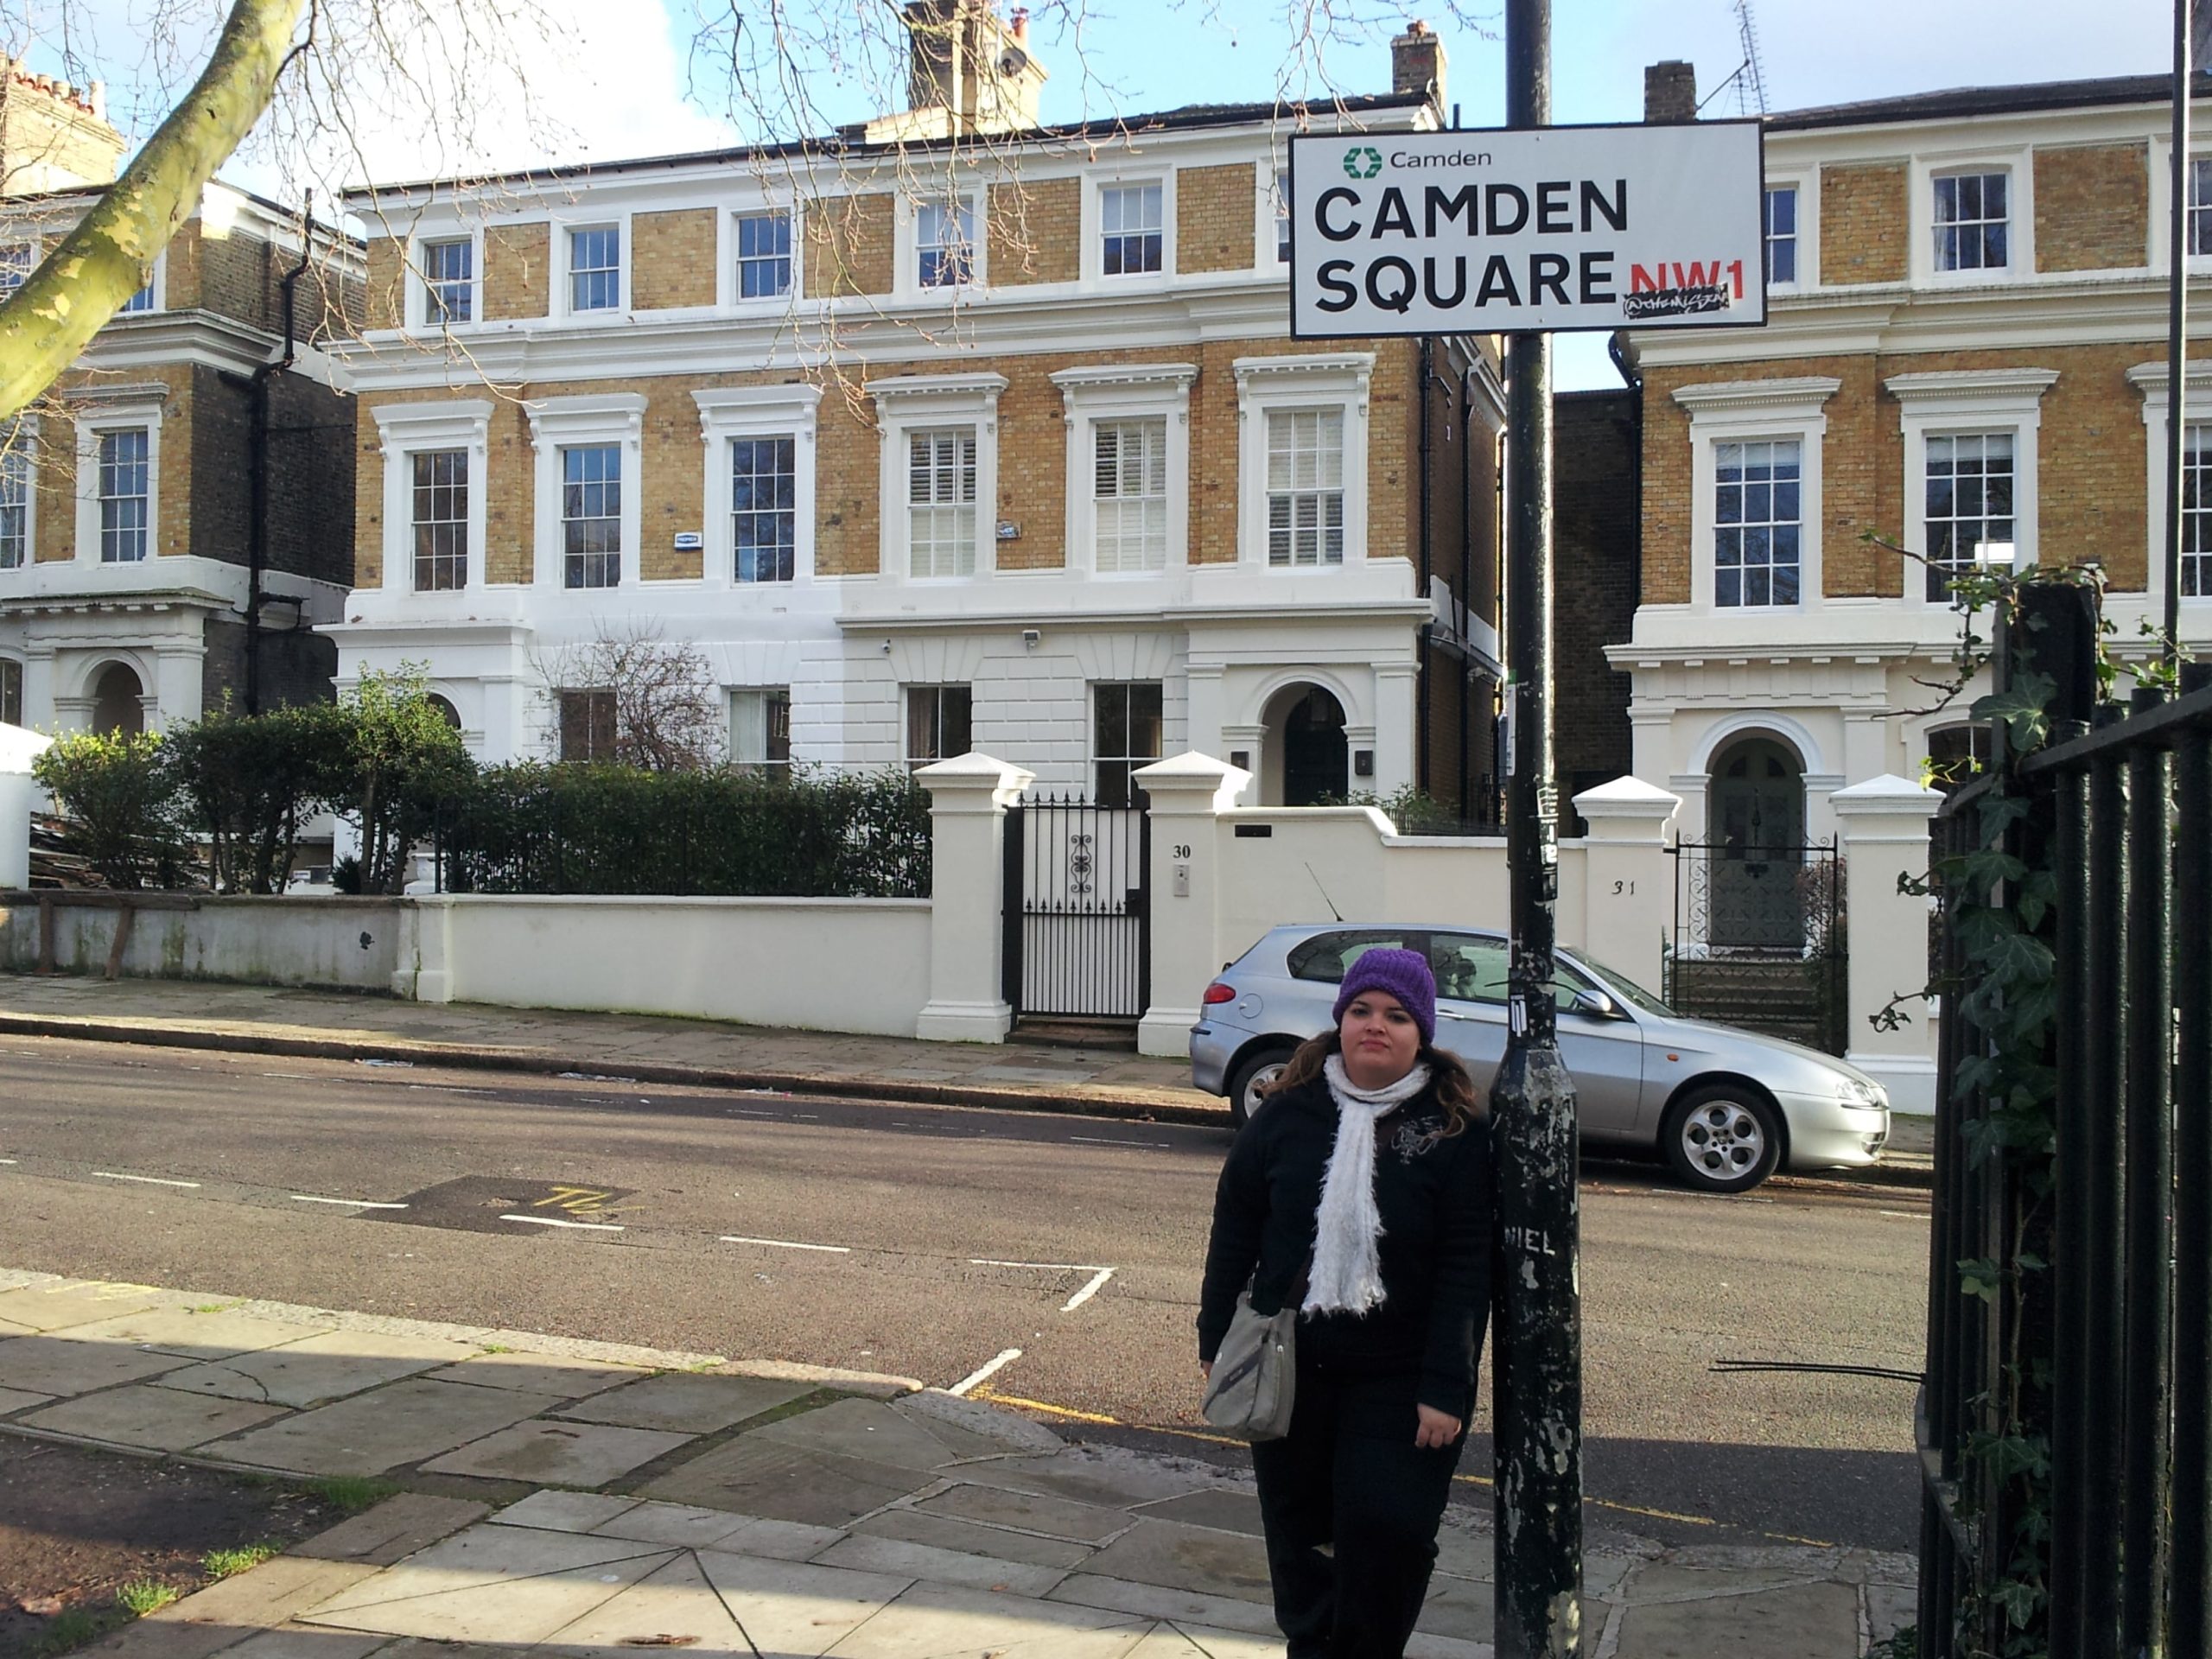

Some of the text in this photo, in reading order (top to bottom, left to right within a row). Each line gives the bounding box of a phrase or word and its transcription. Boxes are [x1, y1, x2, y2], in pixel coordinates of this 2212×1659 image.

[1390, 149, 1491, 168] Camden
[1314, 179, 1627, 241] CAMDEN
[1315, 251, 1743, 315] SQUARE NW1
[1173, 844, 1192, 859] 30
[1611, 880, 1635, 896] 31
